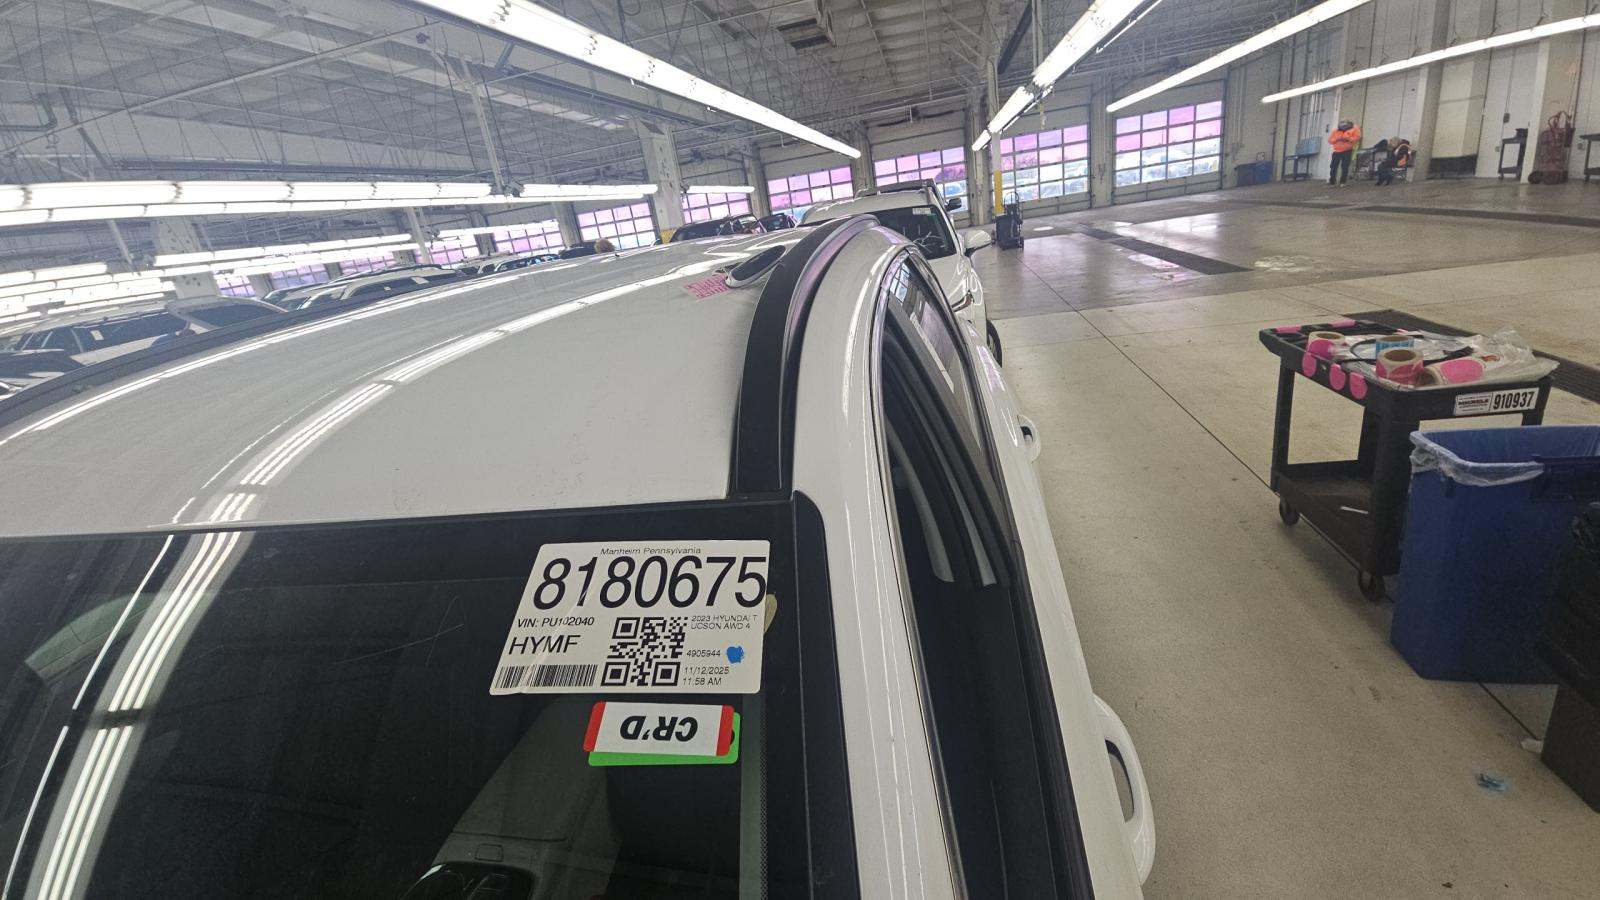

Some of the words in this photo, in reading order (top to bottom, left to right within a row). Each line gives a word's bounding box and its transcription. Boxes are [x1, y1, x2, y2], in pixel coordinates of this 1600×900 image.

[1493, 392, 1534, 409] 910937
[644, 547, 701, 555] Pennsylvania
[533, 556, 766, 609] 8180675
[518, 618, 538, 628] VIN:
[541, 616, 594, 627] PU102040
[508, 635, 580, 654] HYMF
[686, 650, 721, 658] 4905944
[684, 666, 729, 675] 11/12/2025
[683, 678, 705, 686] 11:58
[708, 678, 722, 686] AM
